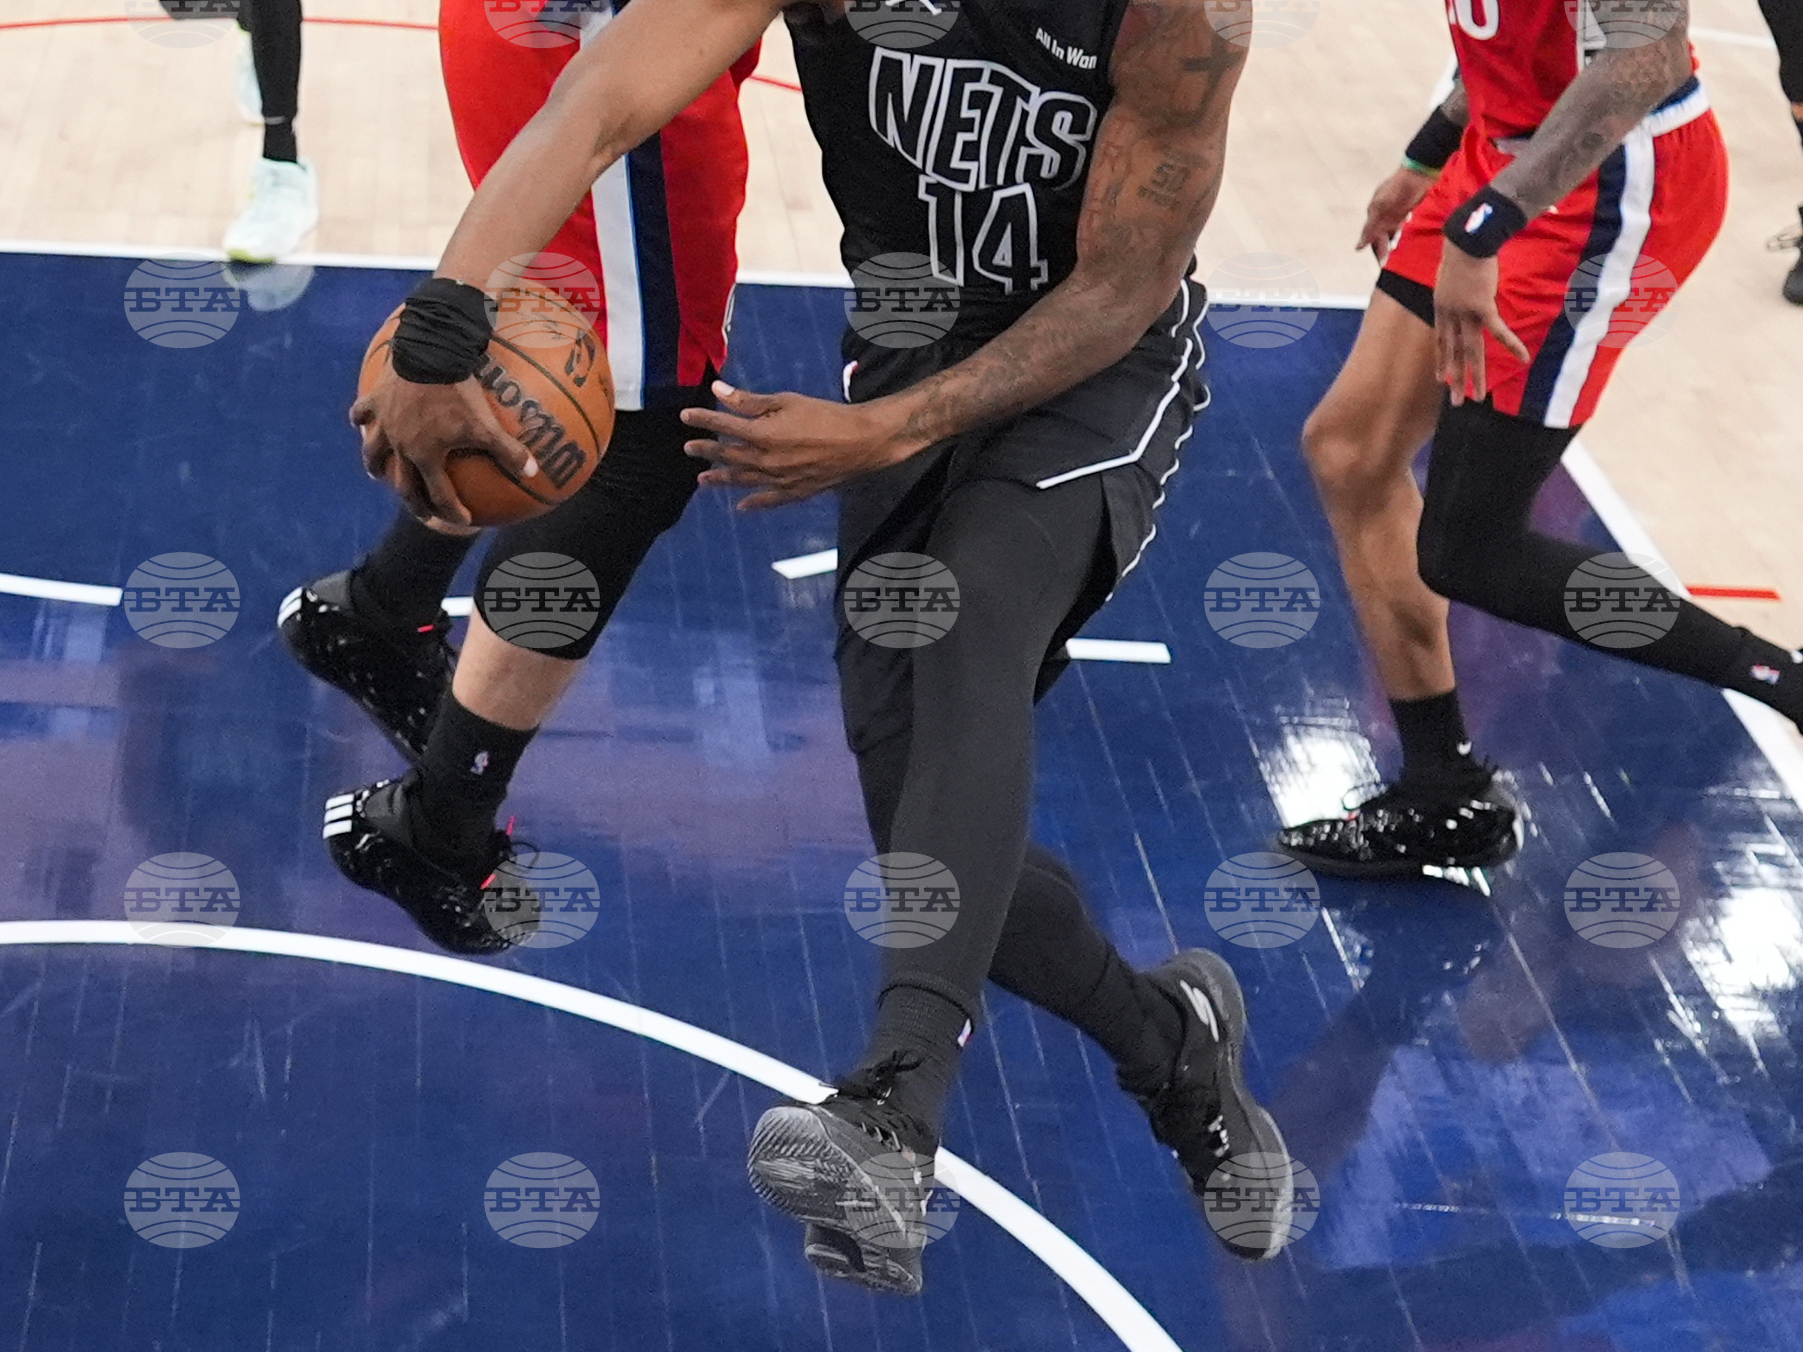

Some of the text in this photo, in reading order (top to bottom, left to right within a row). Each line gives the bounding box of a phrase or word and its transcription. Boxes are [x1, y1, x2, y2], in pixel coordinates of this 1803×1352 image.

[1035, 27, 1052, 51] All
[1051, 39, 1065, 60] In
[868, 46, 1098, 192] NETS
[917, 174, 1049, 295] 14
